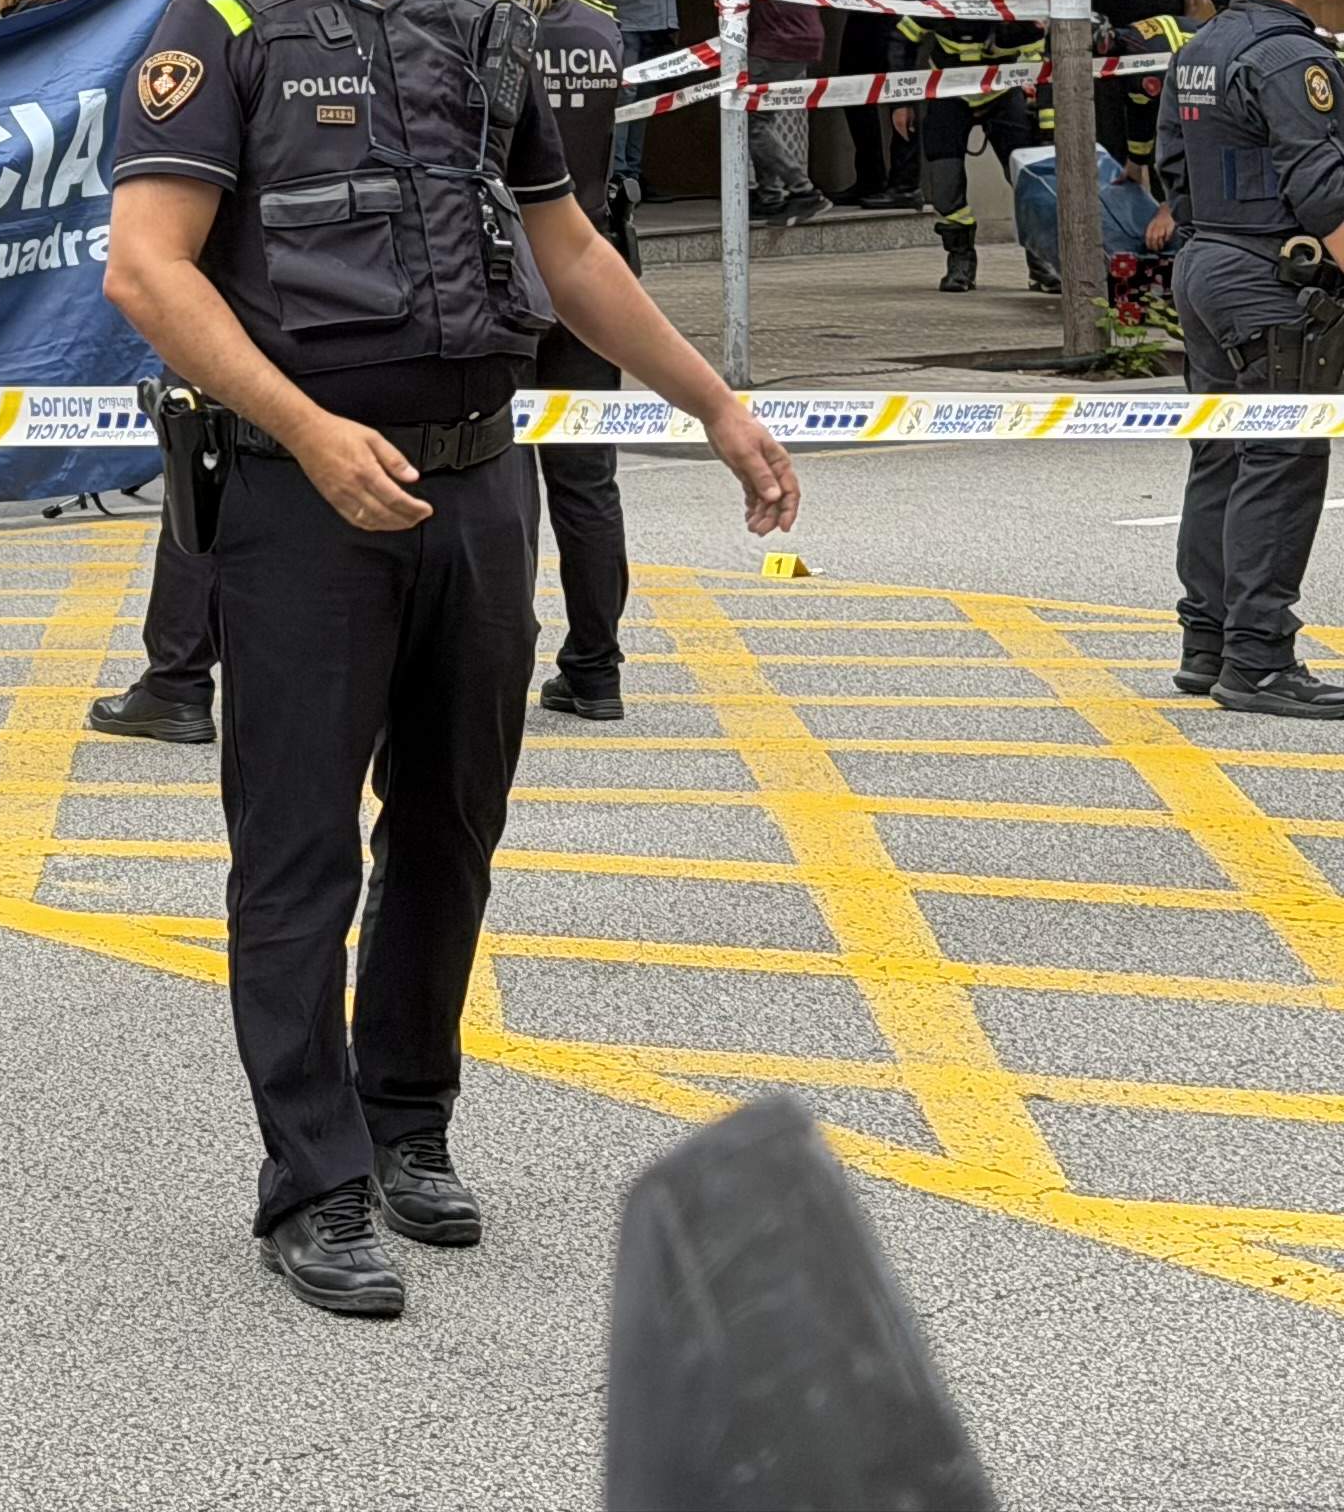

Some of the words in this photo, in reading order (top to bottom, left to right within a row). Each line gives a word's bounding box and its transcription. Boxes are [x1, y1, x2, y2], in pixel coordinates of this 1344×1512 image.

[535, 48, 617, 74] LICIA
[282, 76, 376, 100] POLICIA
[565, 76, 618, 89] Urbana
[26, 423, 91, 440] POLICIA
[591, 420, 643, 435] PASSEU
[646, 420, 666, 434] NO
